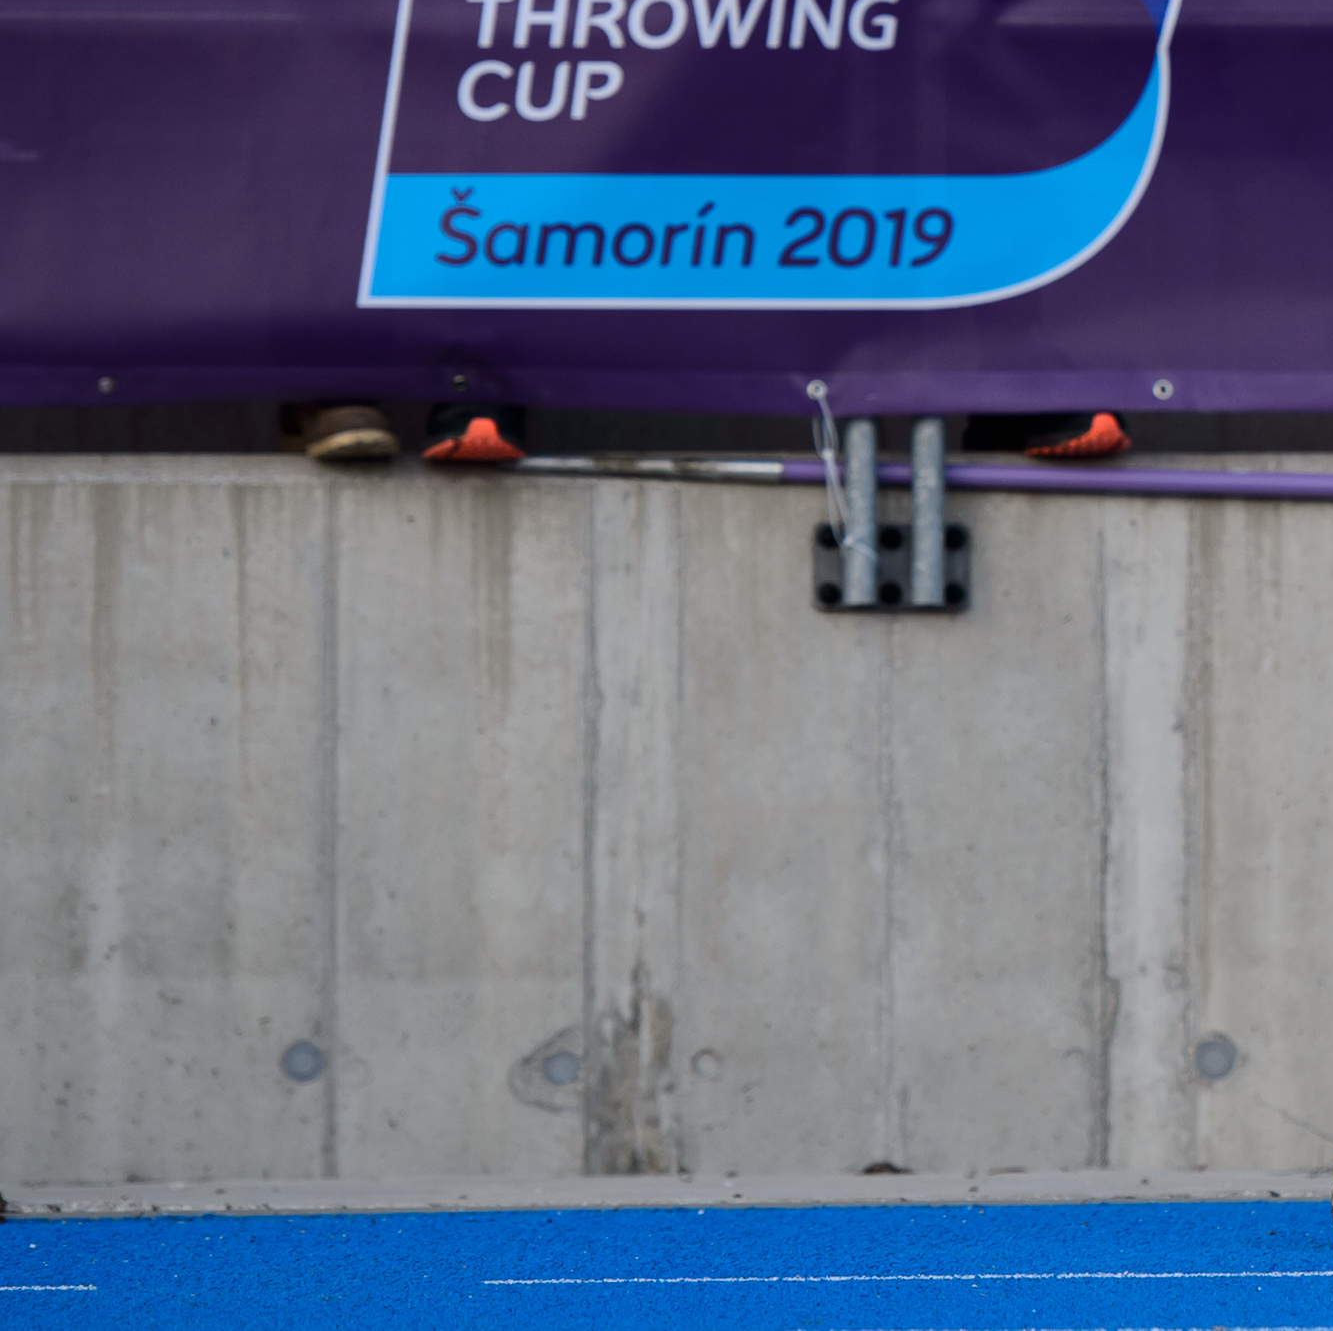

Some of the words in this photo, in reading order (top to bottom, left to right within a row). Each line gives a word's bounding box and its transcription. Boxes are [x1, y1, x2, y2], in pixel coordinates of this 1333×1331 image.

[457, 60, 624, 122] CUP
[437, 188, 756, 268] Šamorín
[777, 206, 955, 269] 2019
